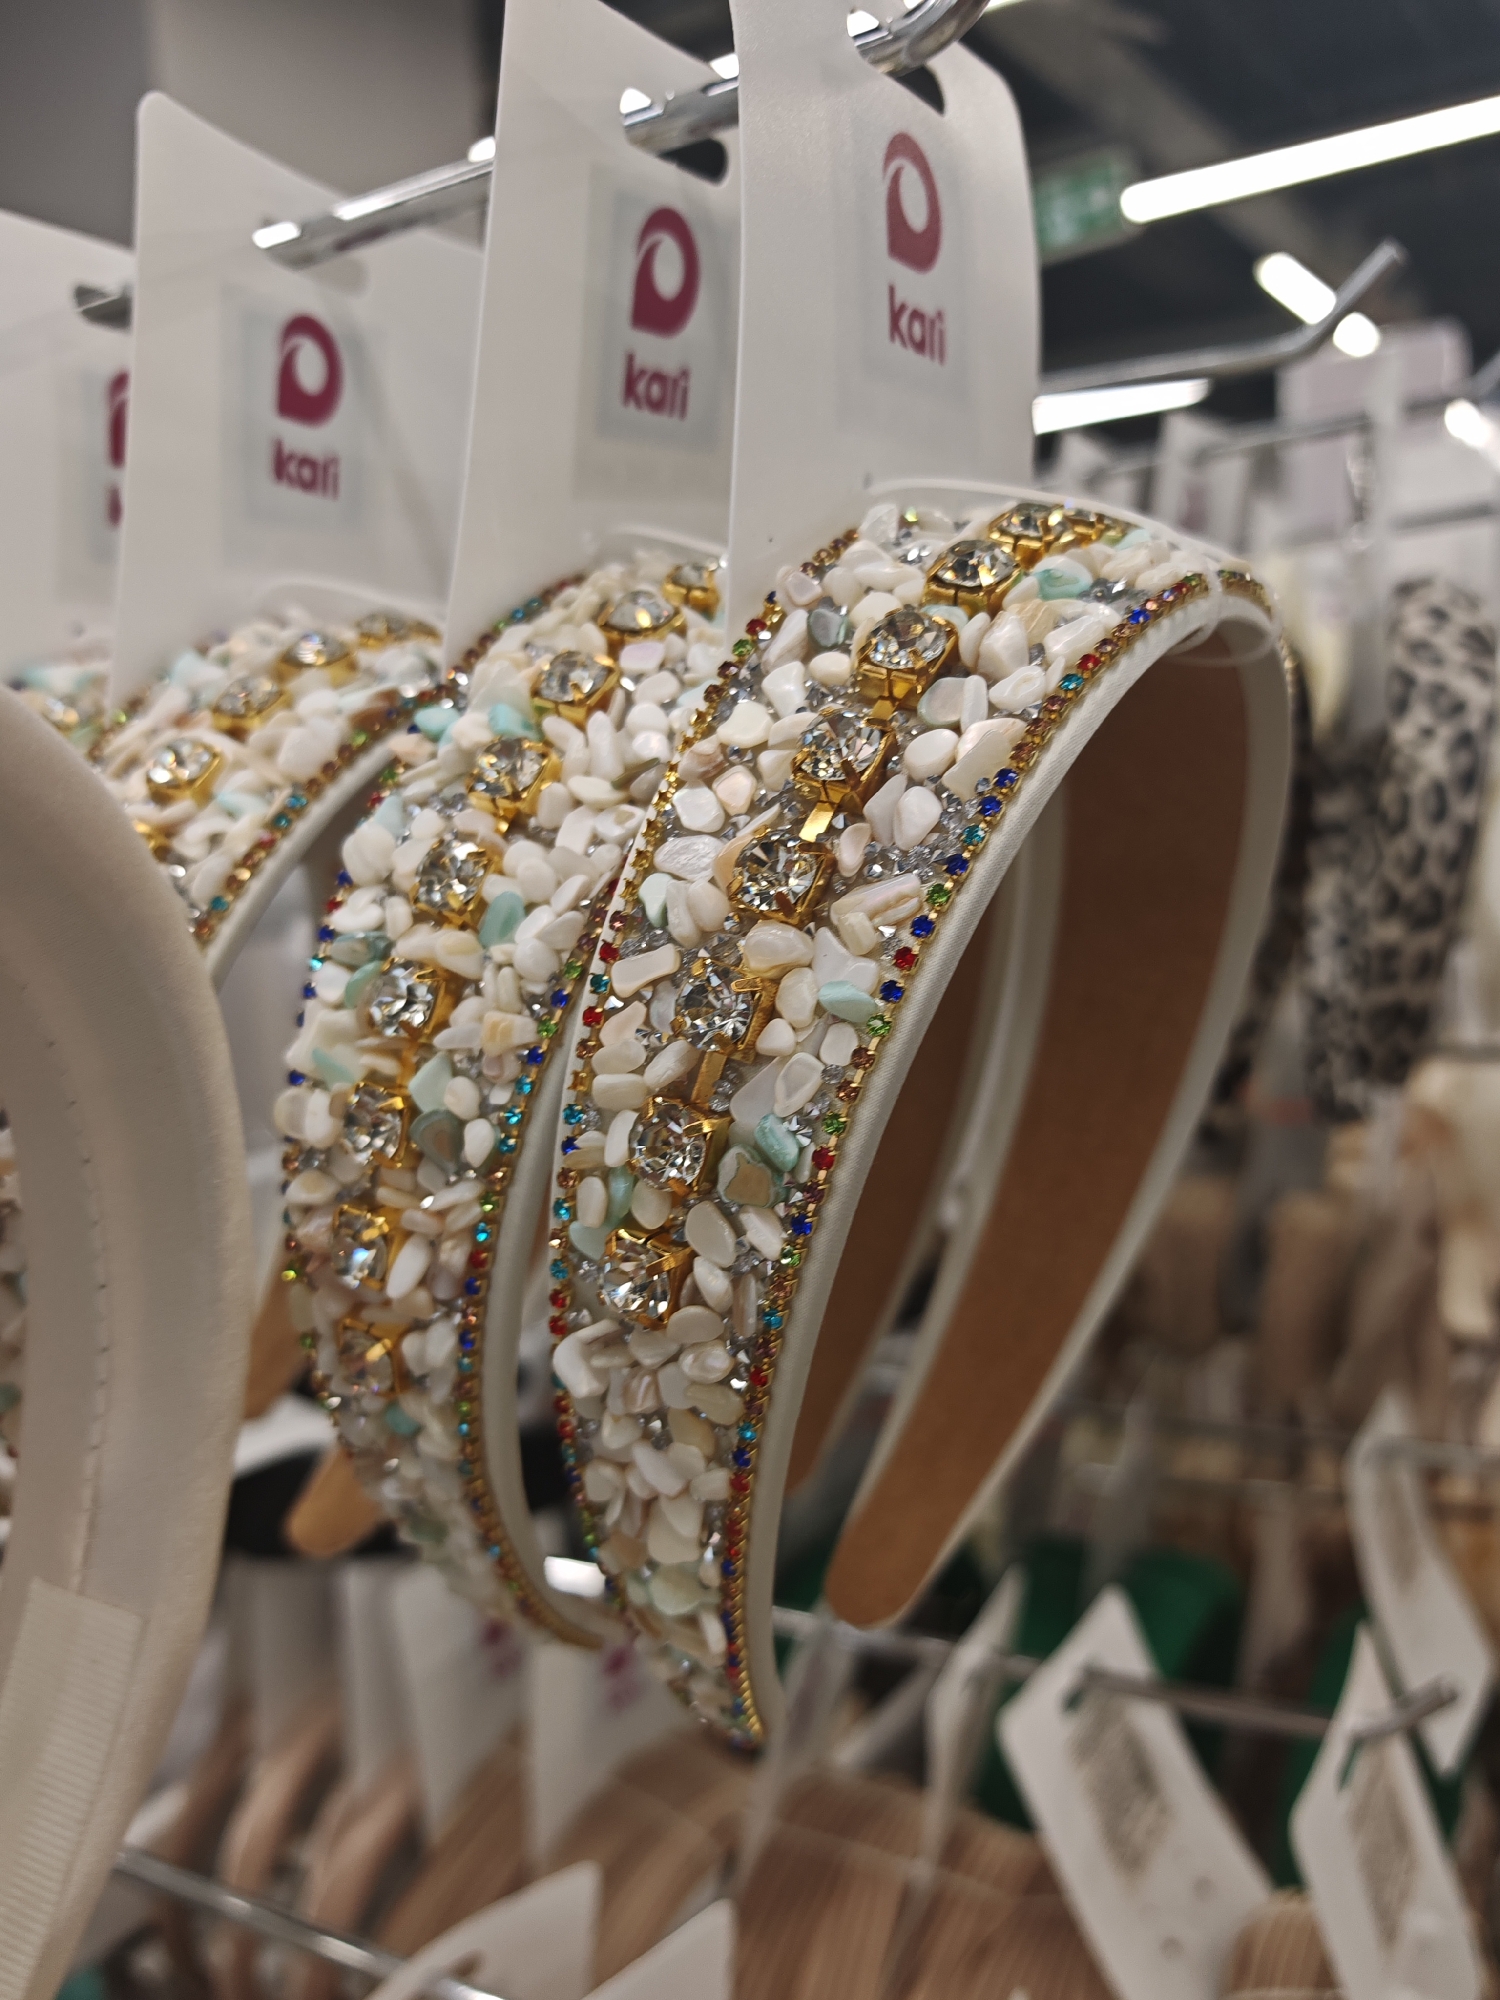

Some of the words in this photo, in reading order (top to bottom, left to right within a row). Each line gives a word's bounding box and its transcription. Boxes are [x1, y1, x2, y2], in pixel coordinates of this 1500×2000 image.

[888, 283, 945, 364] kari
[623, 352, 689, 419] kari
[272, 438, 338, 499] kari
